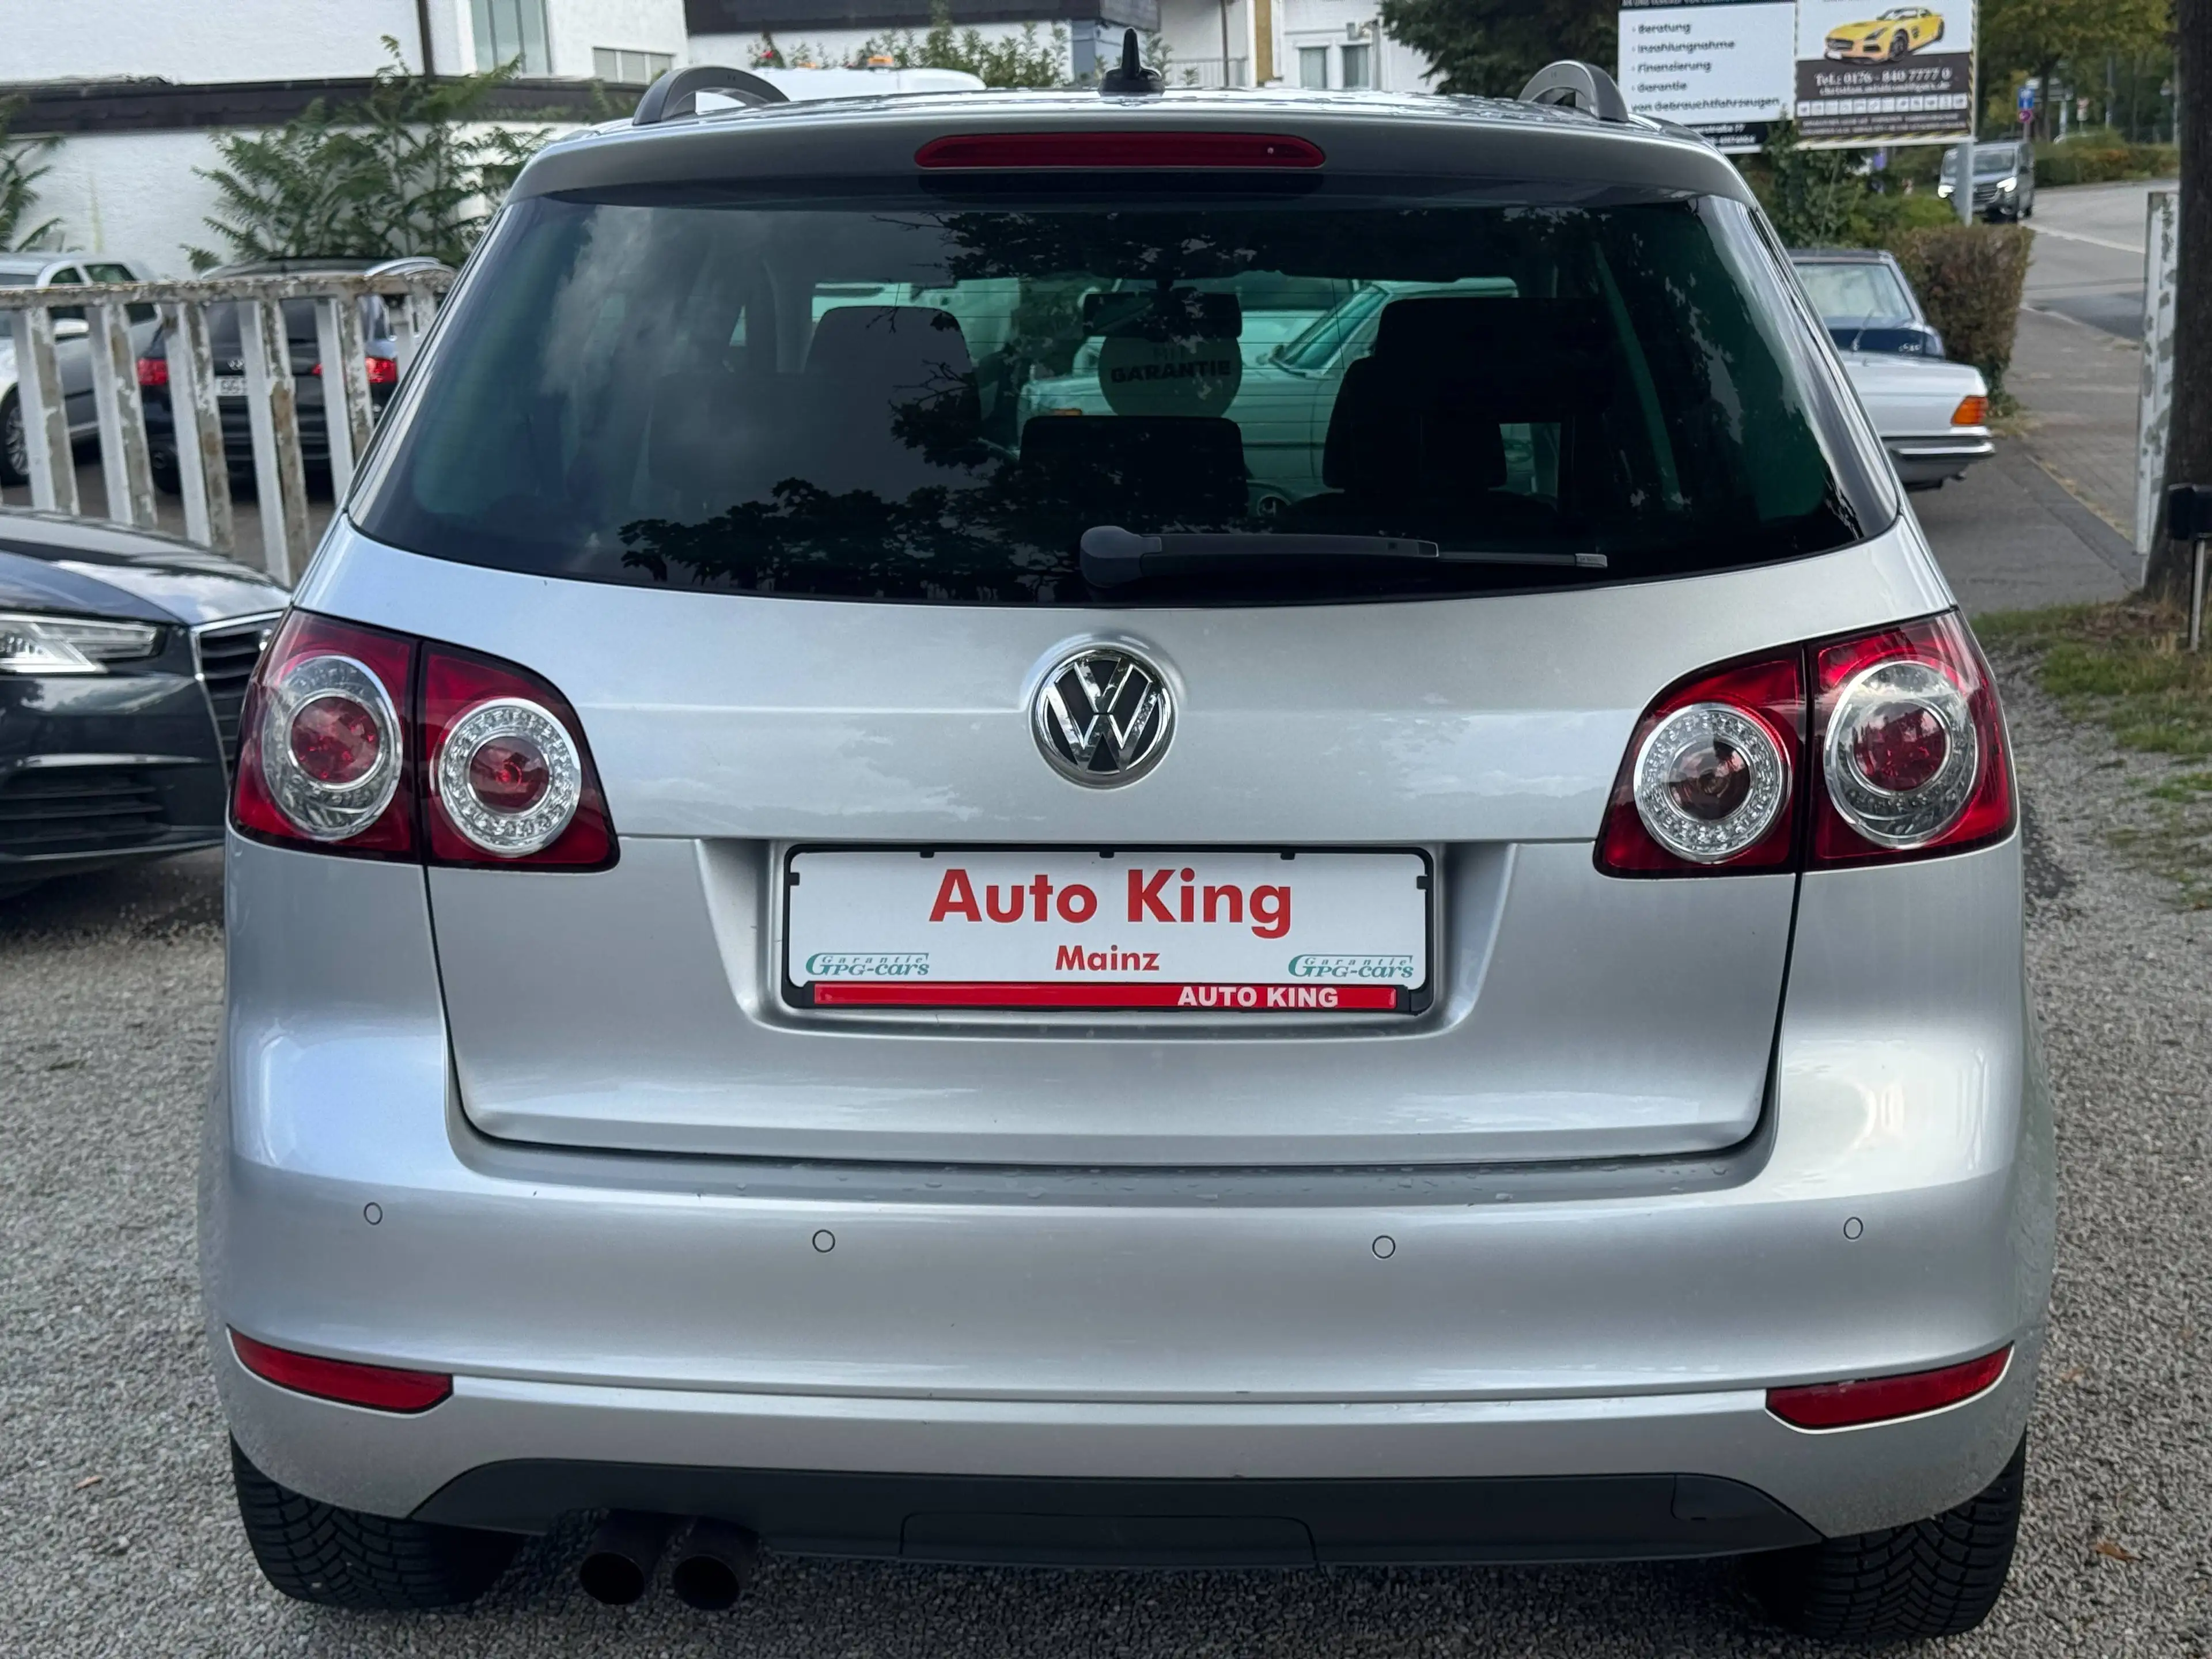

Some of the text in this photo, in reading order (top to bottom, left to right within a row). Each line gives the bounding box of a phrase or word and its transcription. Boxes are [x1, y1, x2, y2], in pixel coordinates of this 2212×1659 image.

[1638, 23, 1691, 35] Beratung
[1638, 40, 1736, 54] Inzahlungnahme
[1638, 61, 1712, 73] Finanzierung
[1638, 81, 1687, 93] Garantie
[1631, 96, 1780, 112] von Gebrauchtfahrzeugen
[1111, 360, 1232, 383] GARANTIE
[1041, 652, 1164, 775] VW
[930, 869, 1291, 939] Auto King
[822, 955, 924, 964] Garantie
[1055, 945, 1158, 971] Mainz
[1304, 957, 1407, 965] Garantie
[1178, 987, 1338, 1007] AUTO KING
